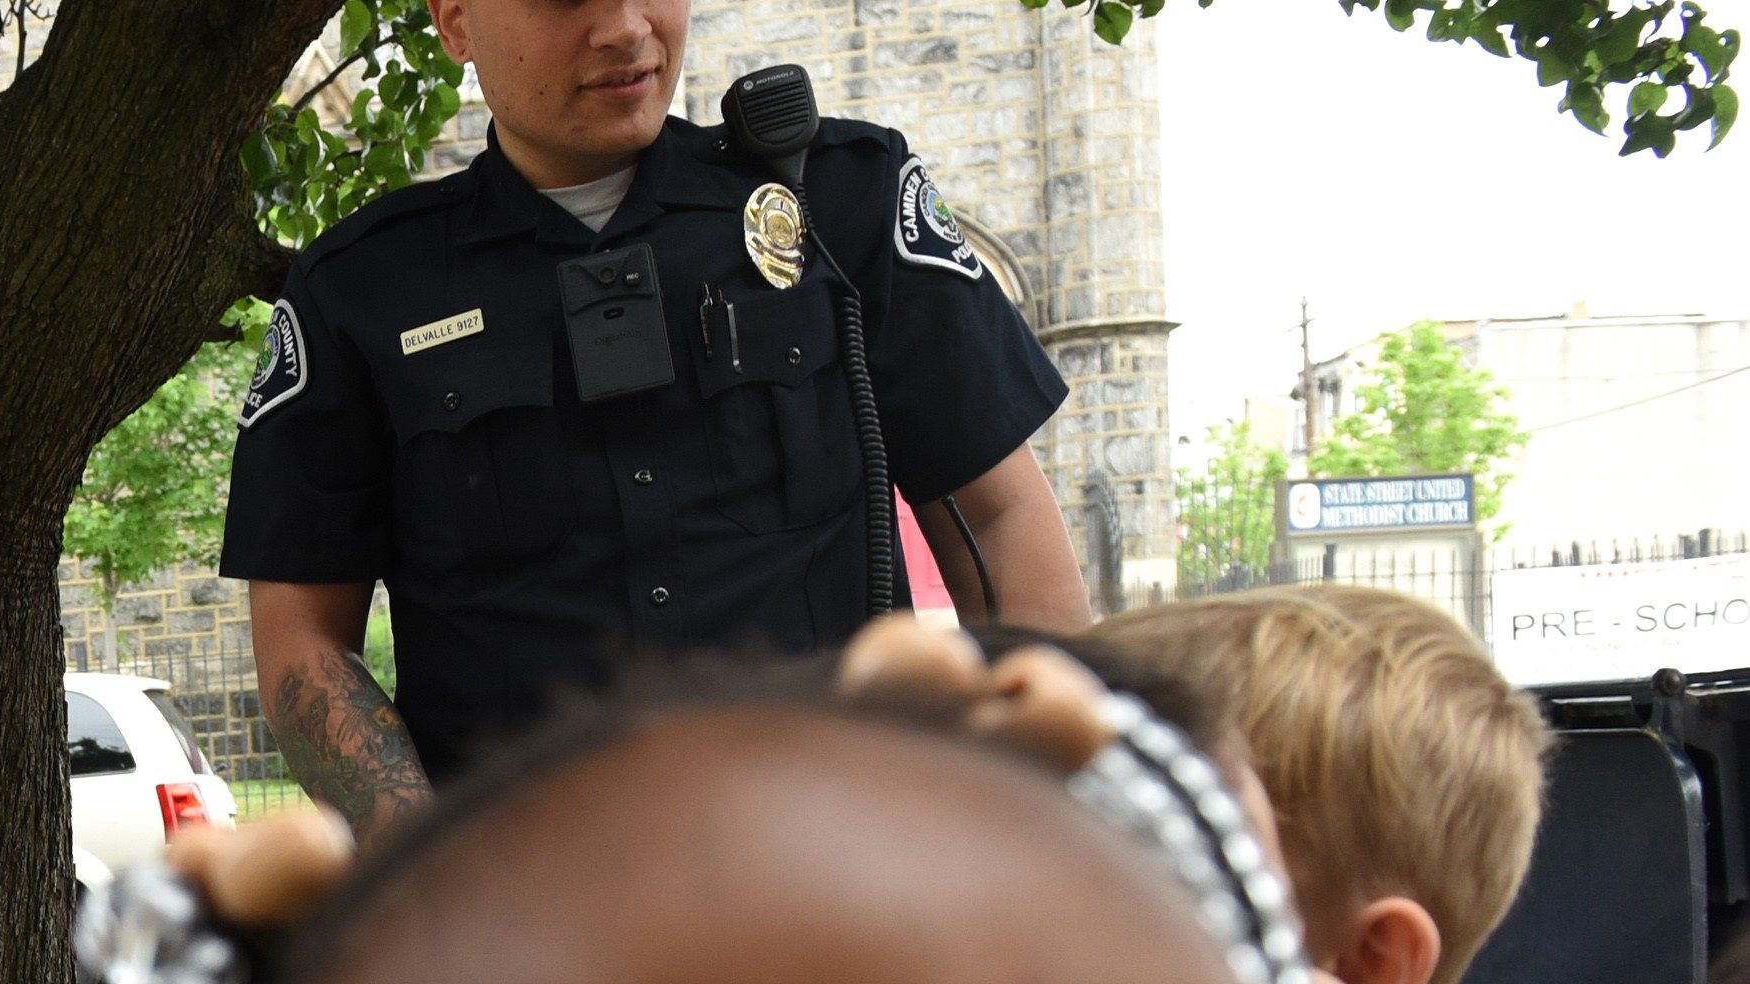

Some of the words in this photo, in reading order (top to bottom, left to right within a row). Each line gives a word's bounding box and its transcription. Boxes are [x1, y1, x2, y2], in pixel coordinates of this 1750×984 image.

[756, 70, 794, 85] MOTOROLA
[902, 171, 922, 242] CAMDEN
[626, 272, 639, 280] REC
[279, 314, 297, 377] COUNTY
[405, 324, 453, 348] DELVALLE
[456, 316, 479, 331] 9127
[1324, 482, 1364, 504] STATE
[1365, 480, 1413, 502] STREET
[1415, 478, 1465, 500] UNITED
[1322, 504, 1404, 527] METHODIST
[1405, 500, 1469, 524] CHURCH
[1512, 609, 1595, 640] PRE
[1636, 598, 1750, 632] SCHO
